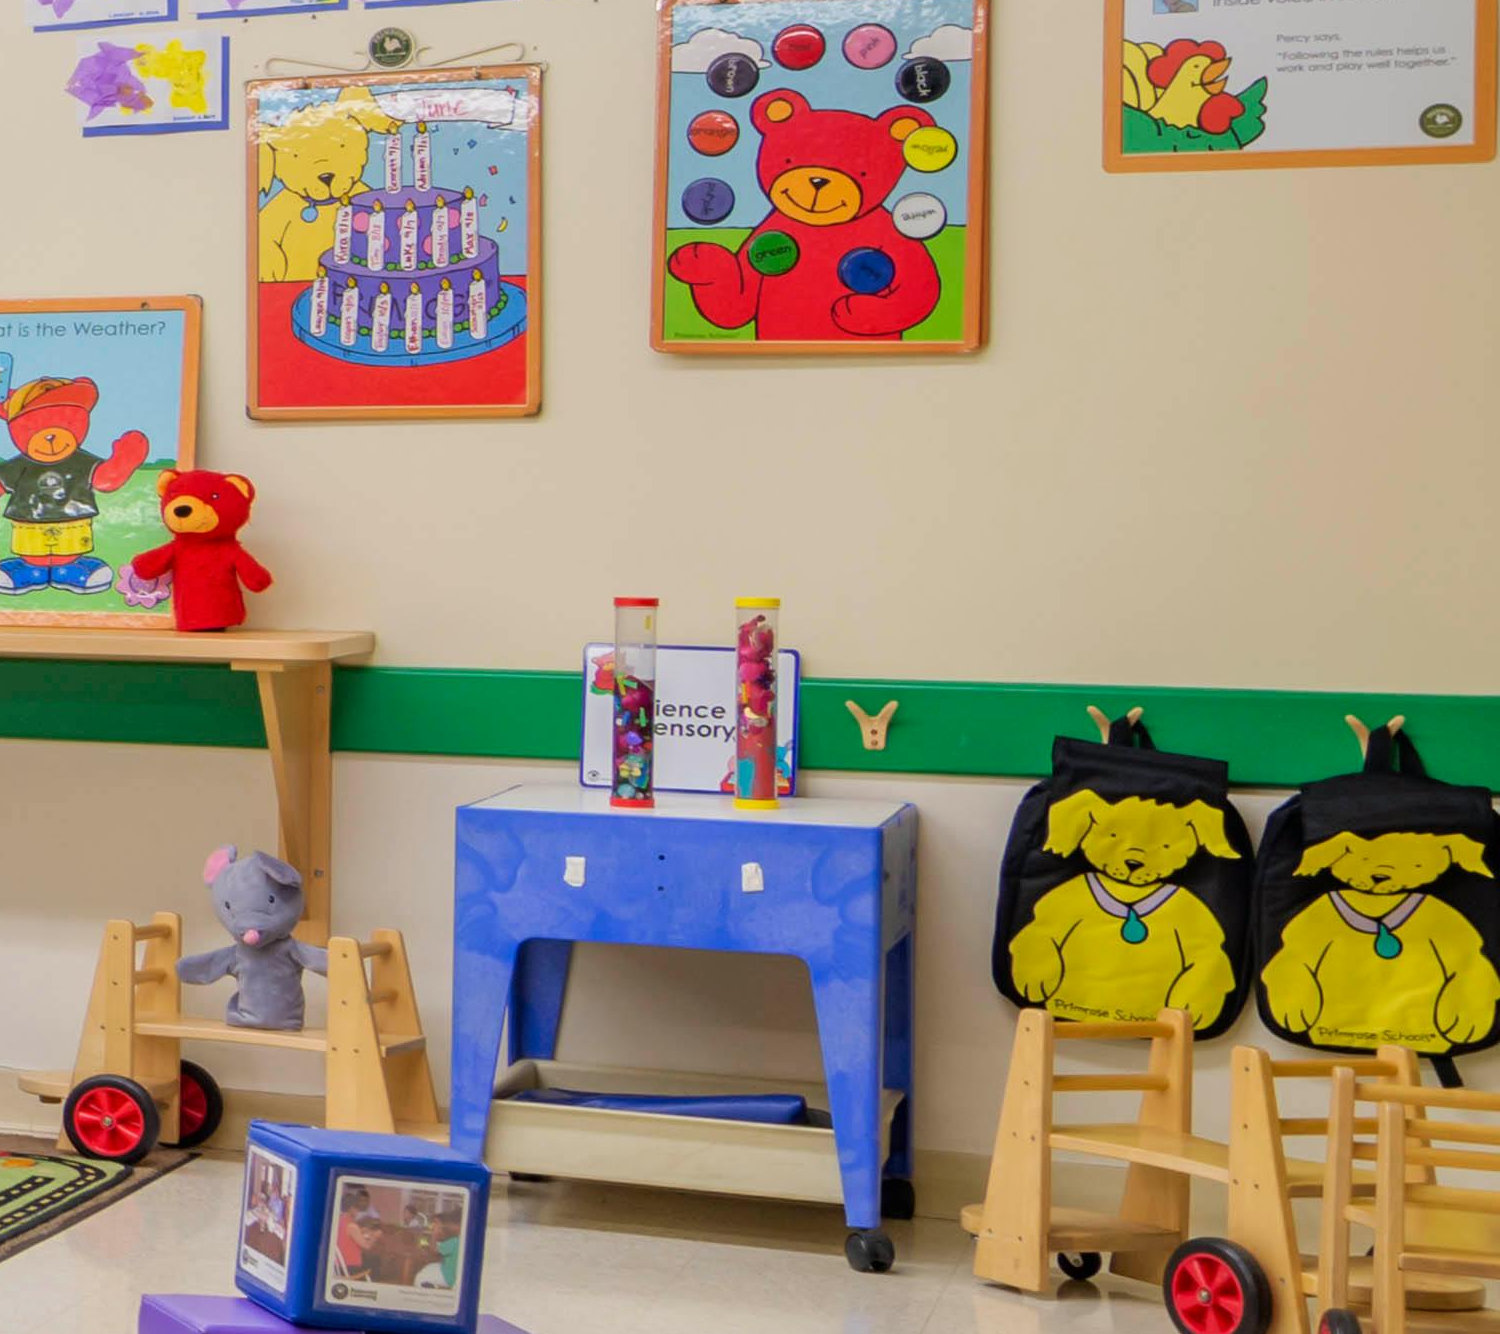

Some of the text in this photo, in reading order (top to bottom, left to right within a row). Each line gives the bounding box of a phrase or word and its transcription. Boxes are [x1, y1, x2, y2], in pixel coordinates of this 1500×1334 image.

[726, 57, 739, 94] brown
[914, 63, 930, 97] black
[754, 243, 793, 264] green
[17, 321, 30, 338] is
[35, 321, 67, 338] the
[72, 319, 167, 337] Weather?
[655, 699, 727, 720] ience
[654, 721, 737, 743] ensory
[1055, 998, 1110, 1019] Primrose
[1316, 1025, 1376, 1042] Primrose
